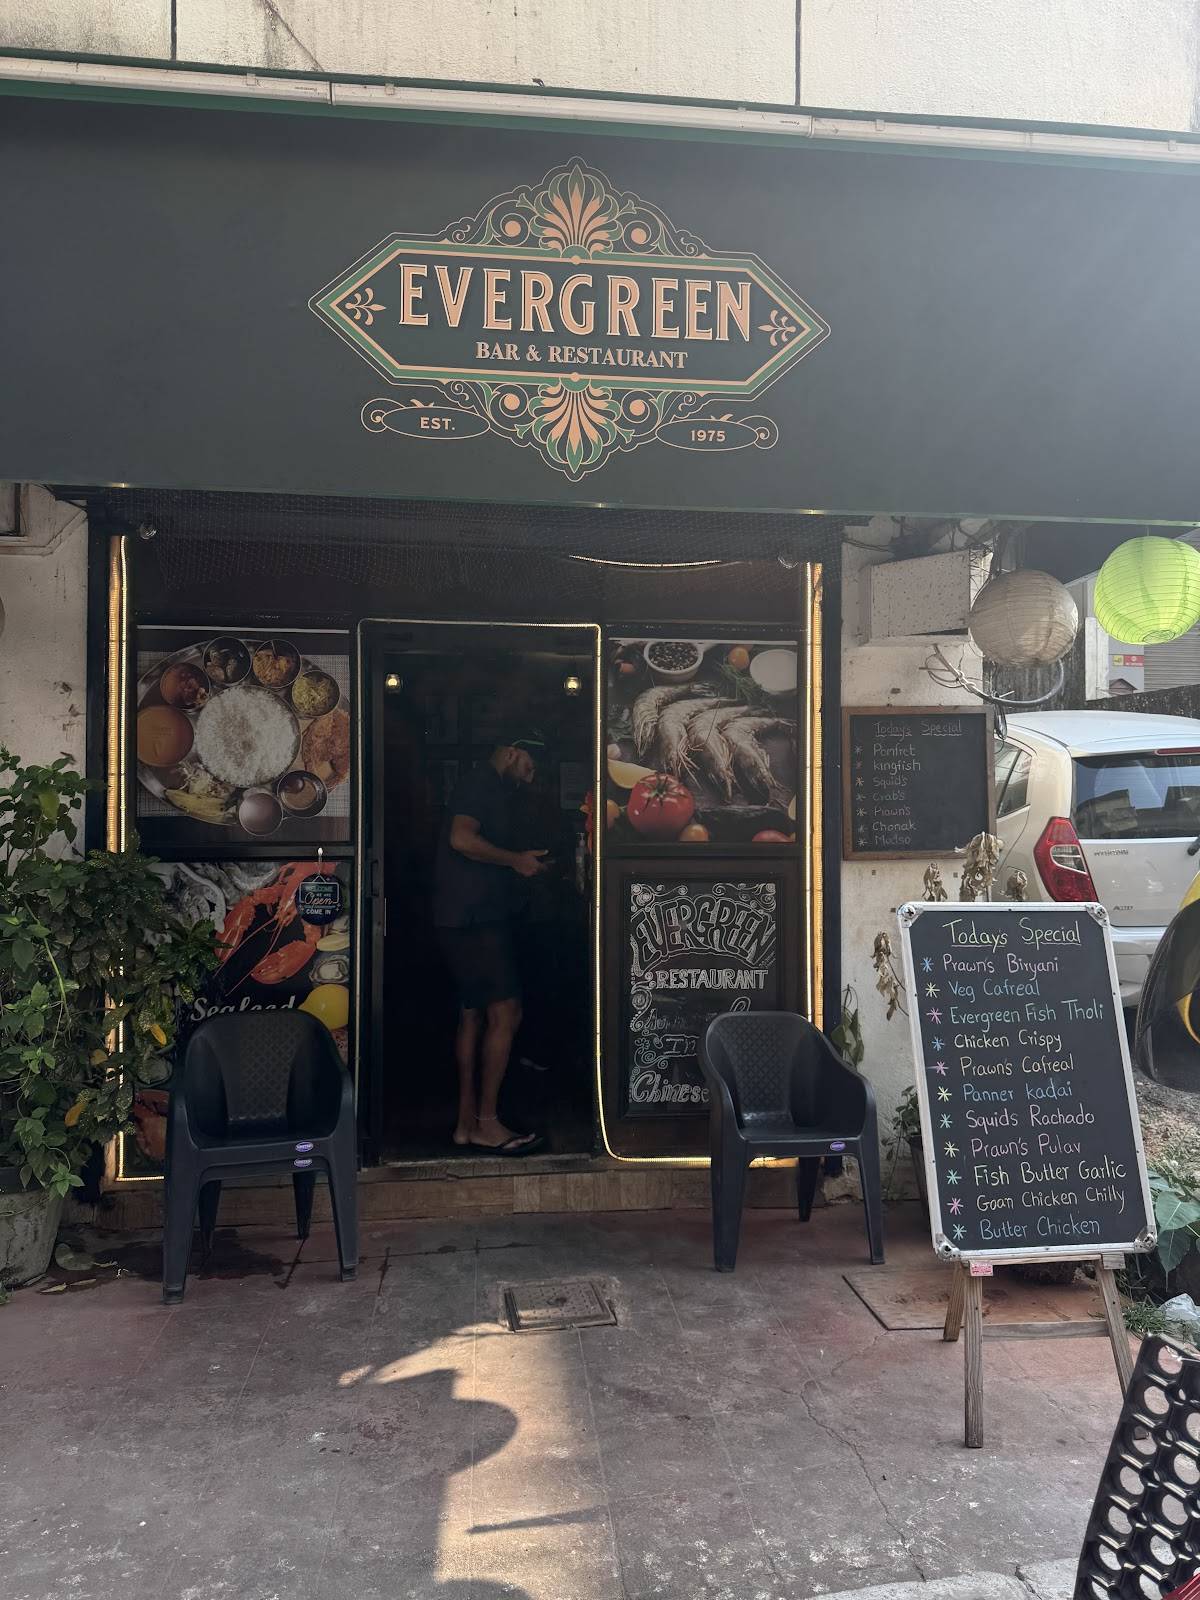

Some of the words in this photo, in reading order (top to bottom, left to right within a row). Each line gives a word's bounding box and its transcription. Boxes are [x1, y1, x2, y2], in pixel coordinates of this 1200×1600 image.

[399, 263, 752, 341] EVERGREEN
[475, 341, 520, 361] BAR
[526, 344, 541, 361] &
[548, 345, 688, 369] RESTAURANT
[420, 416, 456, 431] EST.
[690, 429, 726, 442] 1975
[920, 719, 962, 736] Special
[873, 743, 916, 757] Pomfret
[872, 819, 917, 832] Chonak
[304, 892, 334, 909] Open
[630, 895, 776, 978] EVERGREEN
[1019, 917, 1081, 951] Special
[655, 968, 769, 989] RESTAURANT
[1007, 952, 1059, 981] Biryani
[948, 980, 976, 1003] Veg
[983, 978, 1040, 997] Cafreal
[950, 1006, 1020, 1032] Evergreen
[1025, 1002, 1057, 1021] Fish
[954, 1033, 1010, 1048] Chicken
[1018, 1029, 1063, 1052] Crispy
[1022, 1053, 1074, 1074] Cafreal
[631, 1071, 711, 1104] Chinese
[963, 1083, 1013, 1101] Panner
[965, 1107, 1019, 1135] Squids
[1029, 1102, 1095, 1127] Rachado
[971, 1137, 1028, 1158] Prawn's
[1038, 1133, 1081, 1155] Pulav
[974, 1164, 1010, 1186] Fish
[1020, 1161, 1069, 1184] Butter
[1078, 1155, 1127, 1180] Garlic
[976, 1195, 1014, 1212] Goan
[1021, 1190, 1078, 1208] Chicken
[1085, 1184, 1125, 1215] Chilly
[980, 1218, 1028, 1240] Butter
[1037, 1213, 1100, 1237] Chicken
